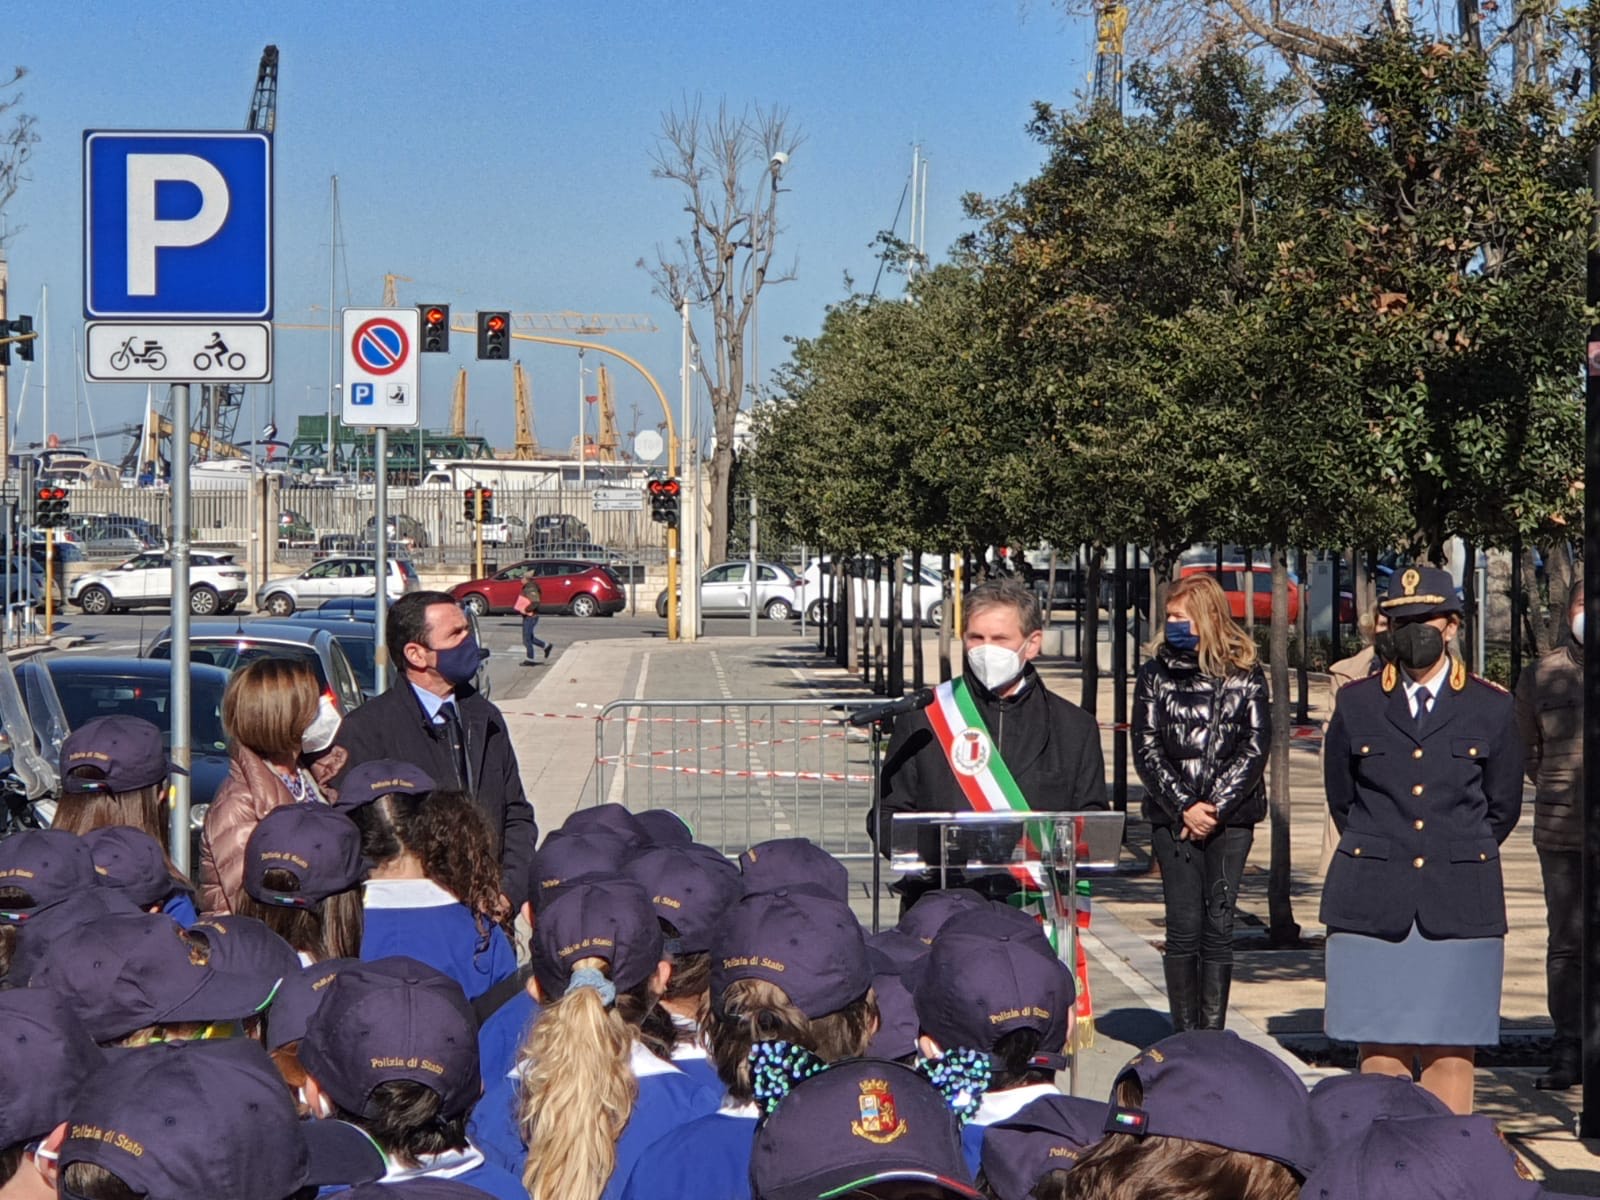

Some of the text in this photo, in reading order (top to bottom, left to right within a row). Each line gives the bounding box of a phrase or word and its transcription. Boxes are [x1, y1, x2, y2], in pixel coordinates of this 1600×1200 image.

[127, 153, 230, 296] P
[356, 385, 370, 403] P
[749, 955, 759, 966] di
[760, 957, 785, 972] Stato
[989, 1008, 1020, 1024] Polizia
[1021, 1006, 1031, 1017] di
[370, 1057, 444, 1075] Polizia di Stato
[71, 1123, 143, 1157] Polizia di Stato
